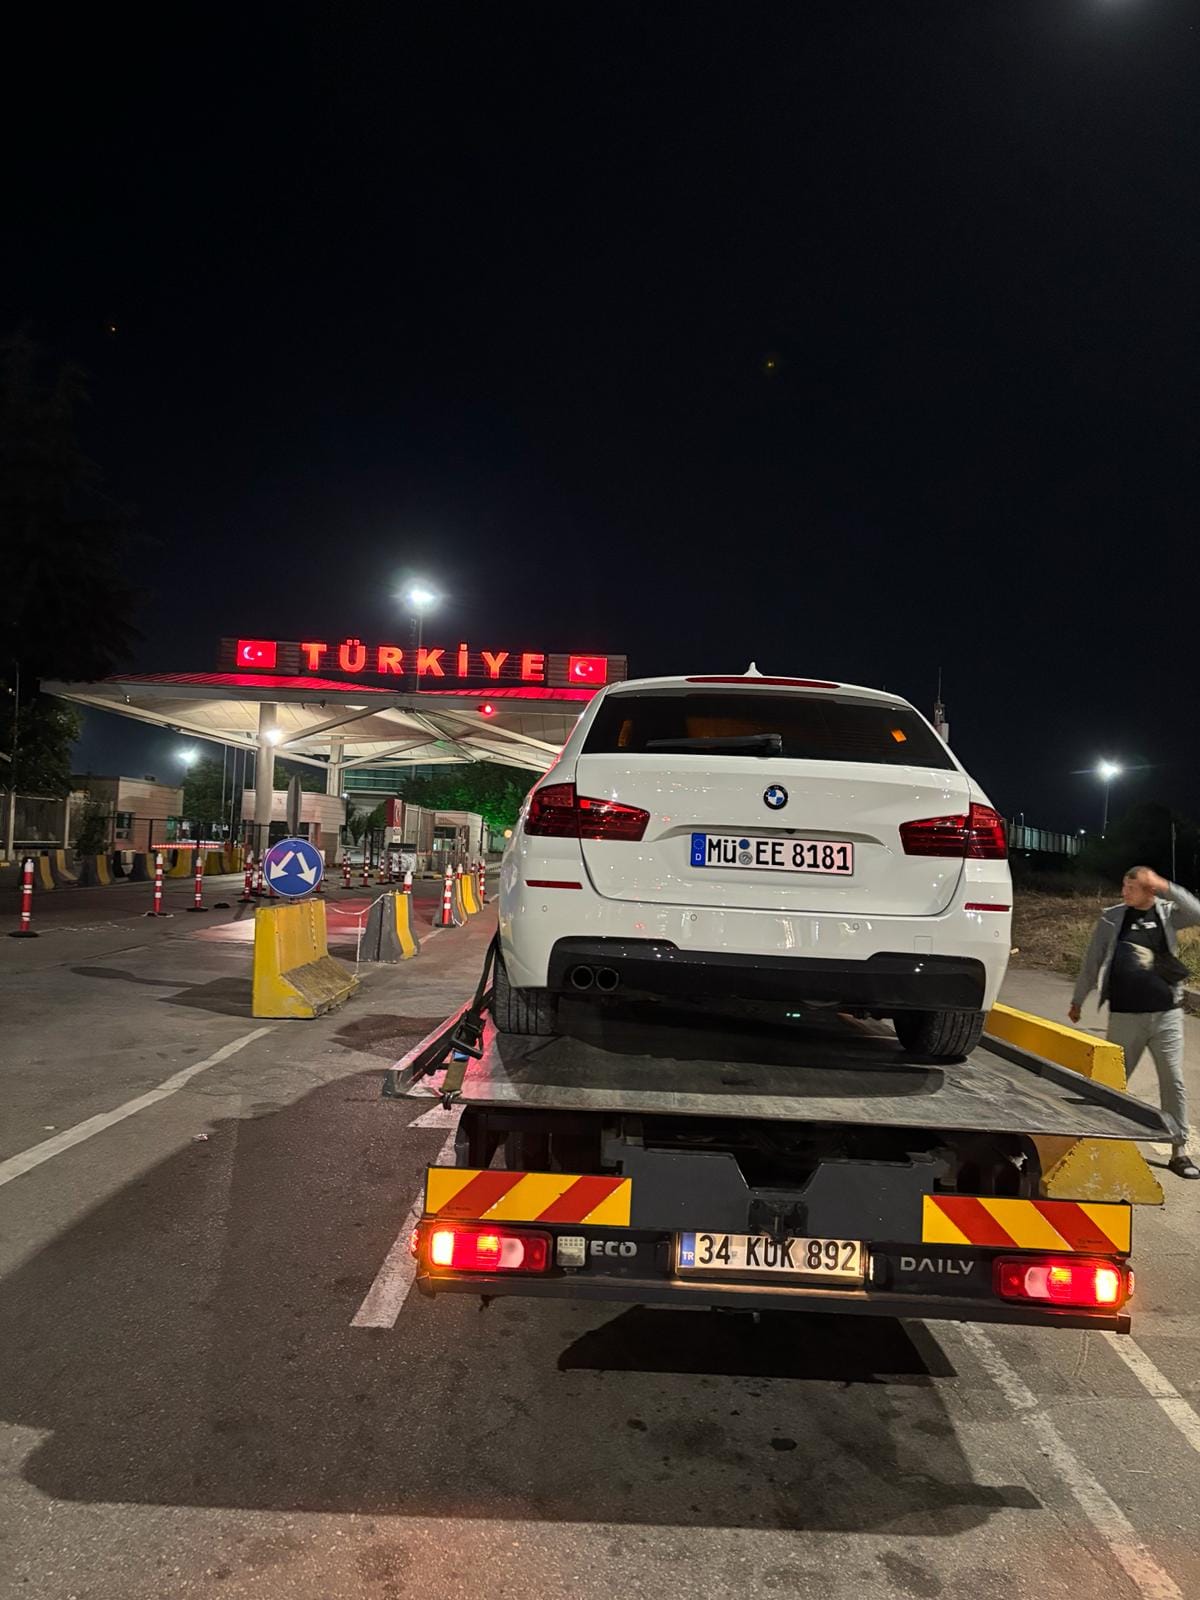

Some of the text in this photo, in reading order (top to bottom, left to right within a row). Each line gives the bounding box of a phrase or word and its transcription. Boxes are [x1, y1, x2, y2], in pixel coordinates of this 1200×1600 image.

[301, 639, 545, 681] TÜRKİYE
[695, 853, 702, 861] D
[755, 841, 785, 866] EE
[792, 843, 850, 870] 8181
[586, 1240, 638, 1257] ECO
[682, 1251, 694, 1260] TR
[699, 1234, 731, 1265] 34
[807, 1240, 857, 1271] 892
[900, 1256, 975, 1275] DAILY
